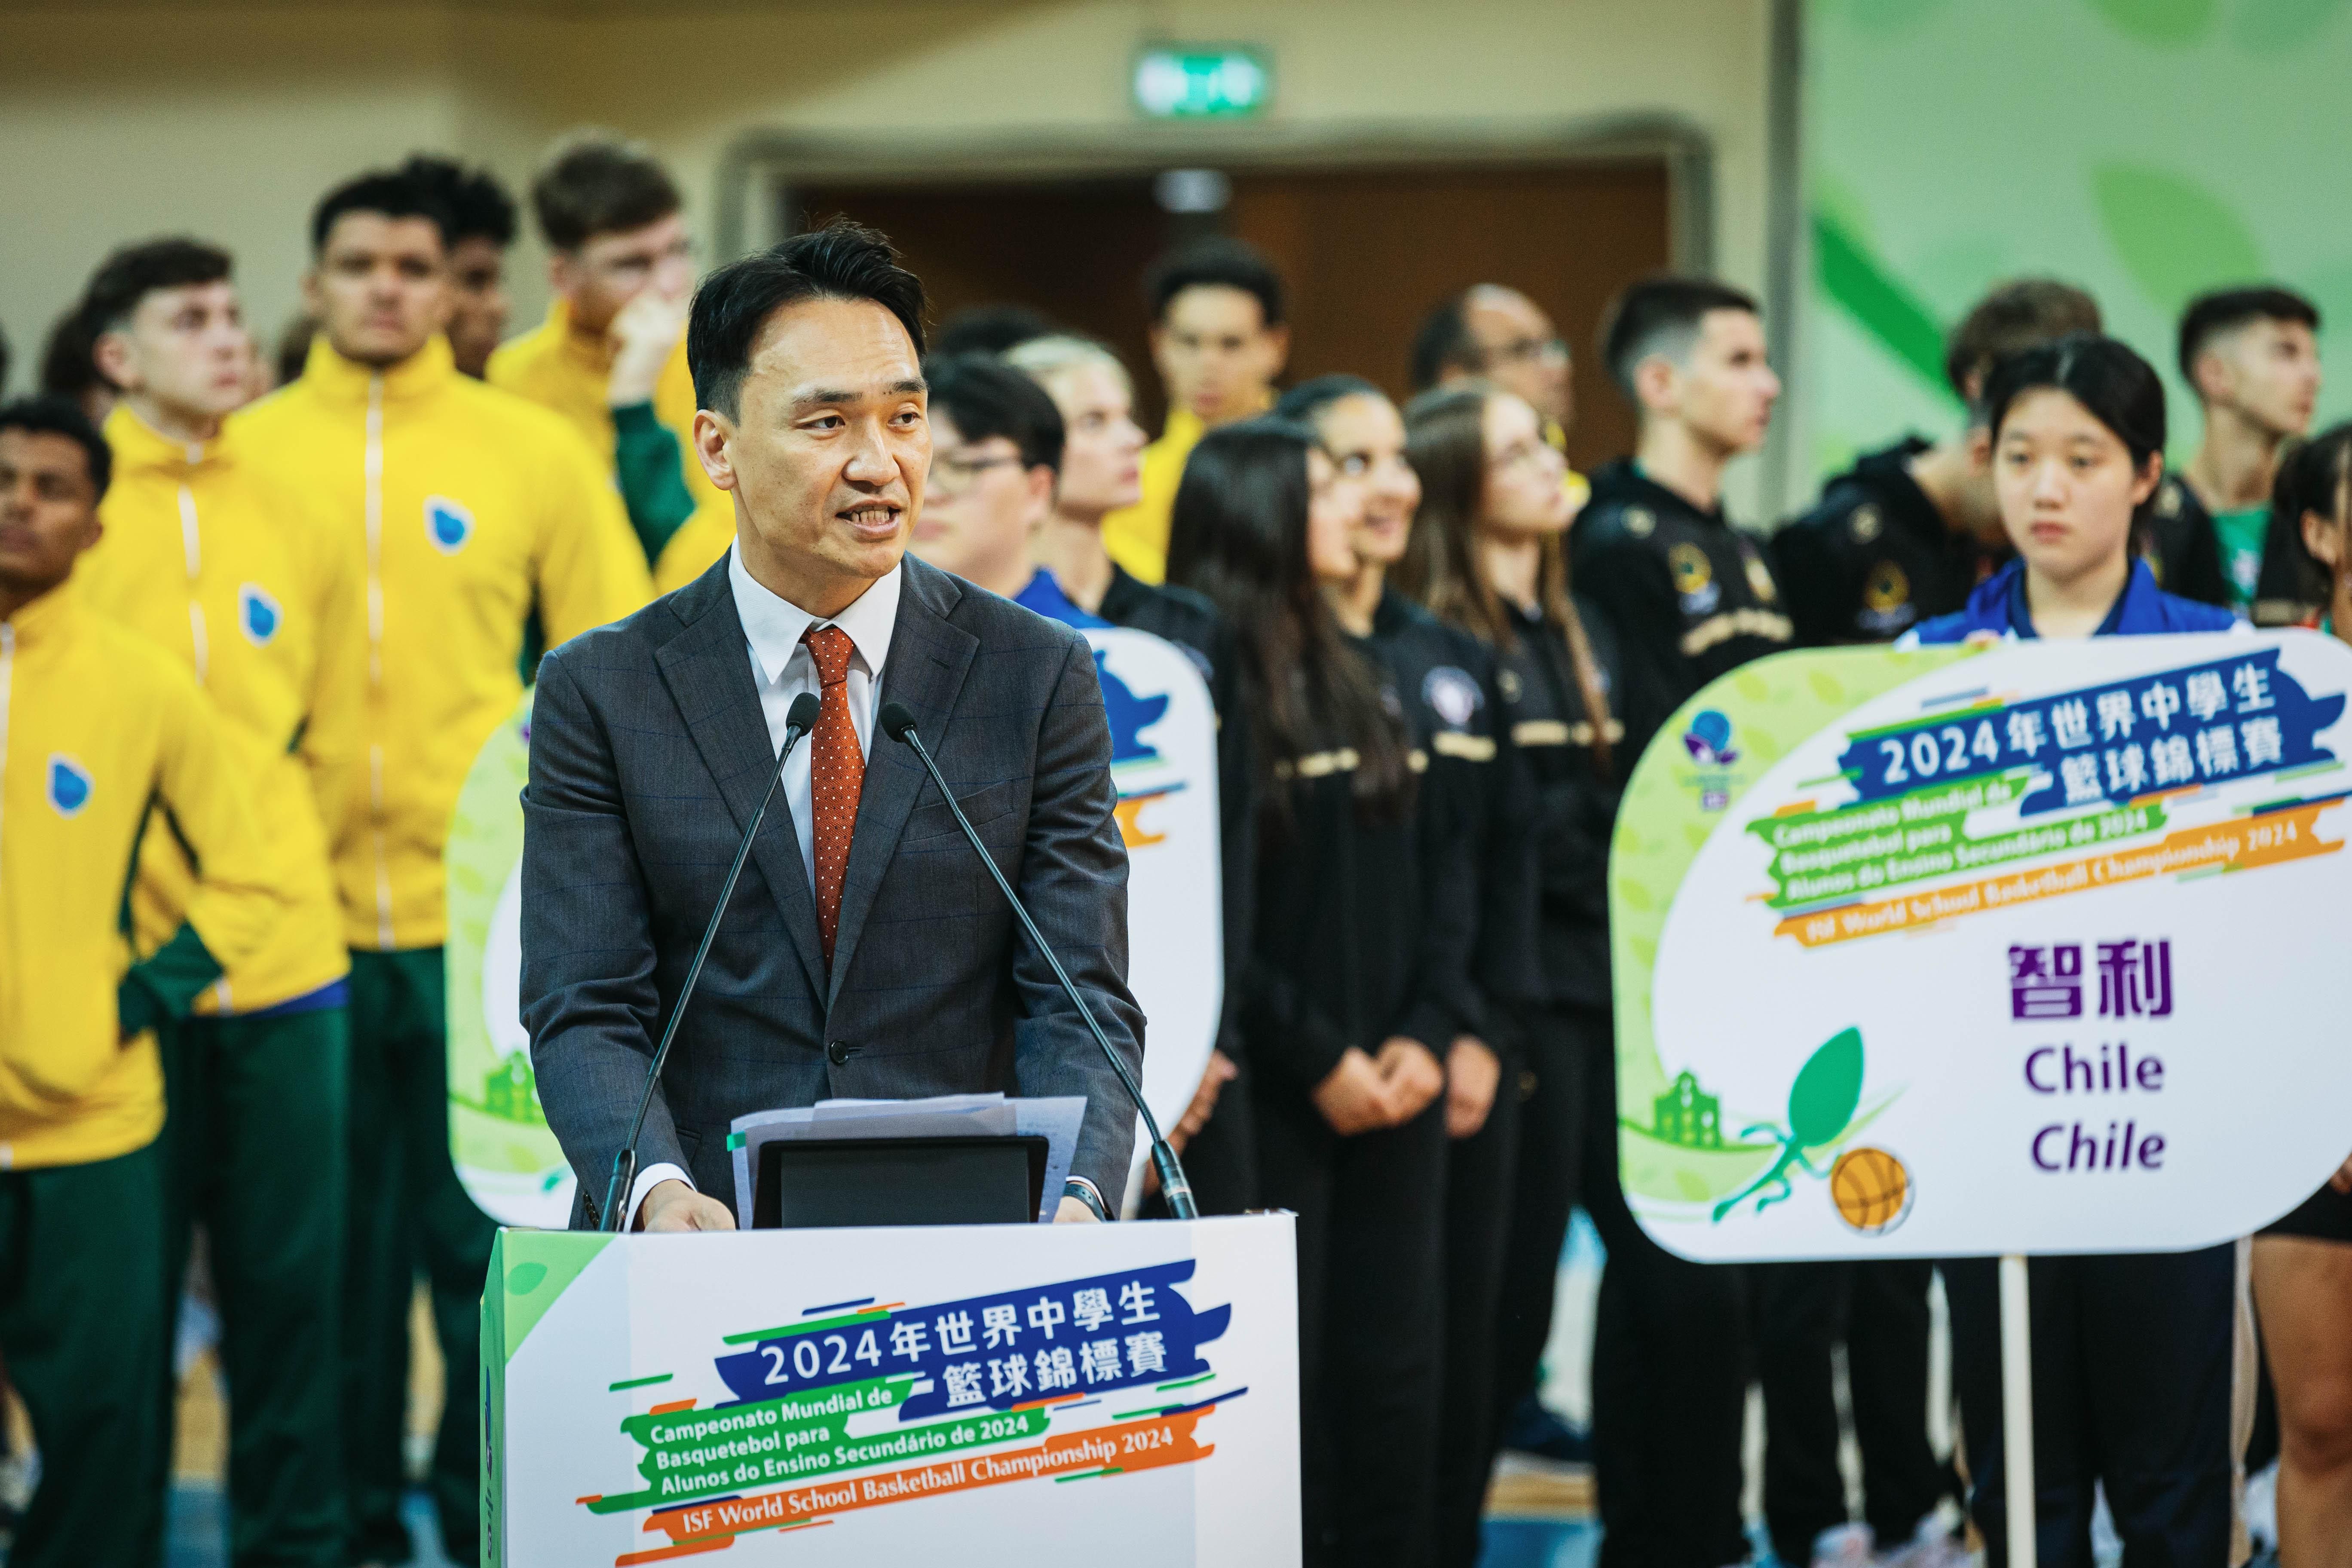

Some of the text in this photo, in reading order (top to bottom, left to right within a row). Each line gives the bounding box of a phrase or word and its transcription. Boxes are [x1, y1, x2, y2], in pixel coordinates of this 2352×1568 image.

[1878, 662, 2276, 784] 2024年世界中學生
[2100, 808, 2148, 839] 2024
[2247, 820, 2297, 851] 2024
[2008, 938, 2172, 1019] 智利
[2024, 1043, 2164, 1093] Chile
[2031, 1119, 2166, 1171] Chile
[760, 1280, 1161, 1385] 2024年世界中學生
[943, 1331, 1168, 1408] 籃球錦標賽
[651, 1387, 892, 1444] Campeonato Mundial de
[656, 1427, 830, 1470] Basquetebol para
[662, 1415, 1029, 1495] Alunos do Ensino Secundário de 2024
[683, 1426, 1174, 1533] ISF World School Basketball Championship 2024
